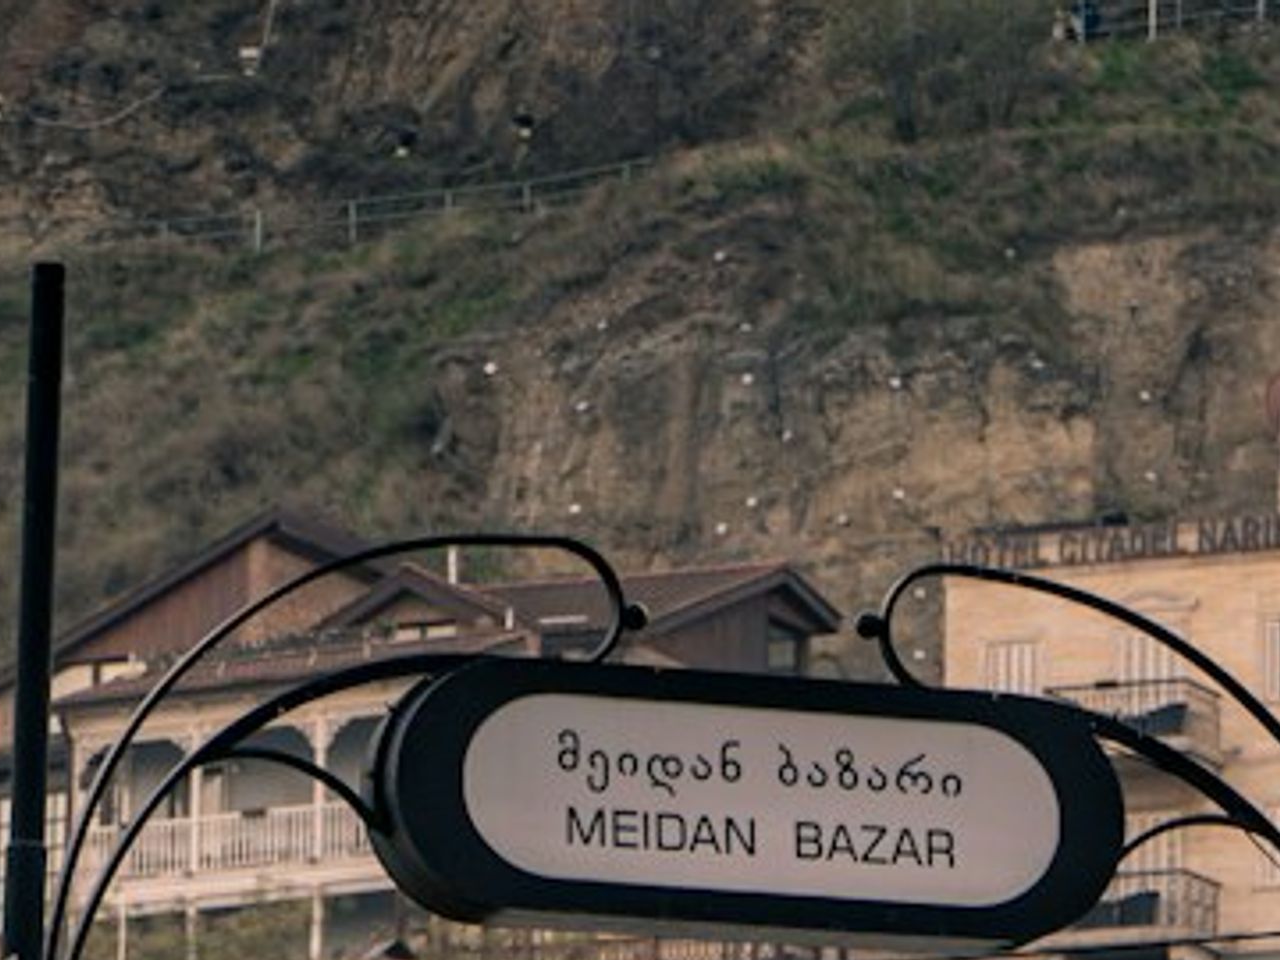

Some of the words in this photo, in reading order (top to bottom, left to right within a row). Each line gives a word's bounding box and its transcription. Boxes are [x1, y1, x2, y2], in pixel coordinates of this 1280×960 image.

[557, 728, 743, 797] მეიდან
[776, 743, 963, 798] ბაზარი
[566, 806, 756, 857] MEIDAN
[794, 820, 955, 869] BAZAR
